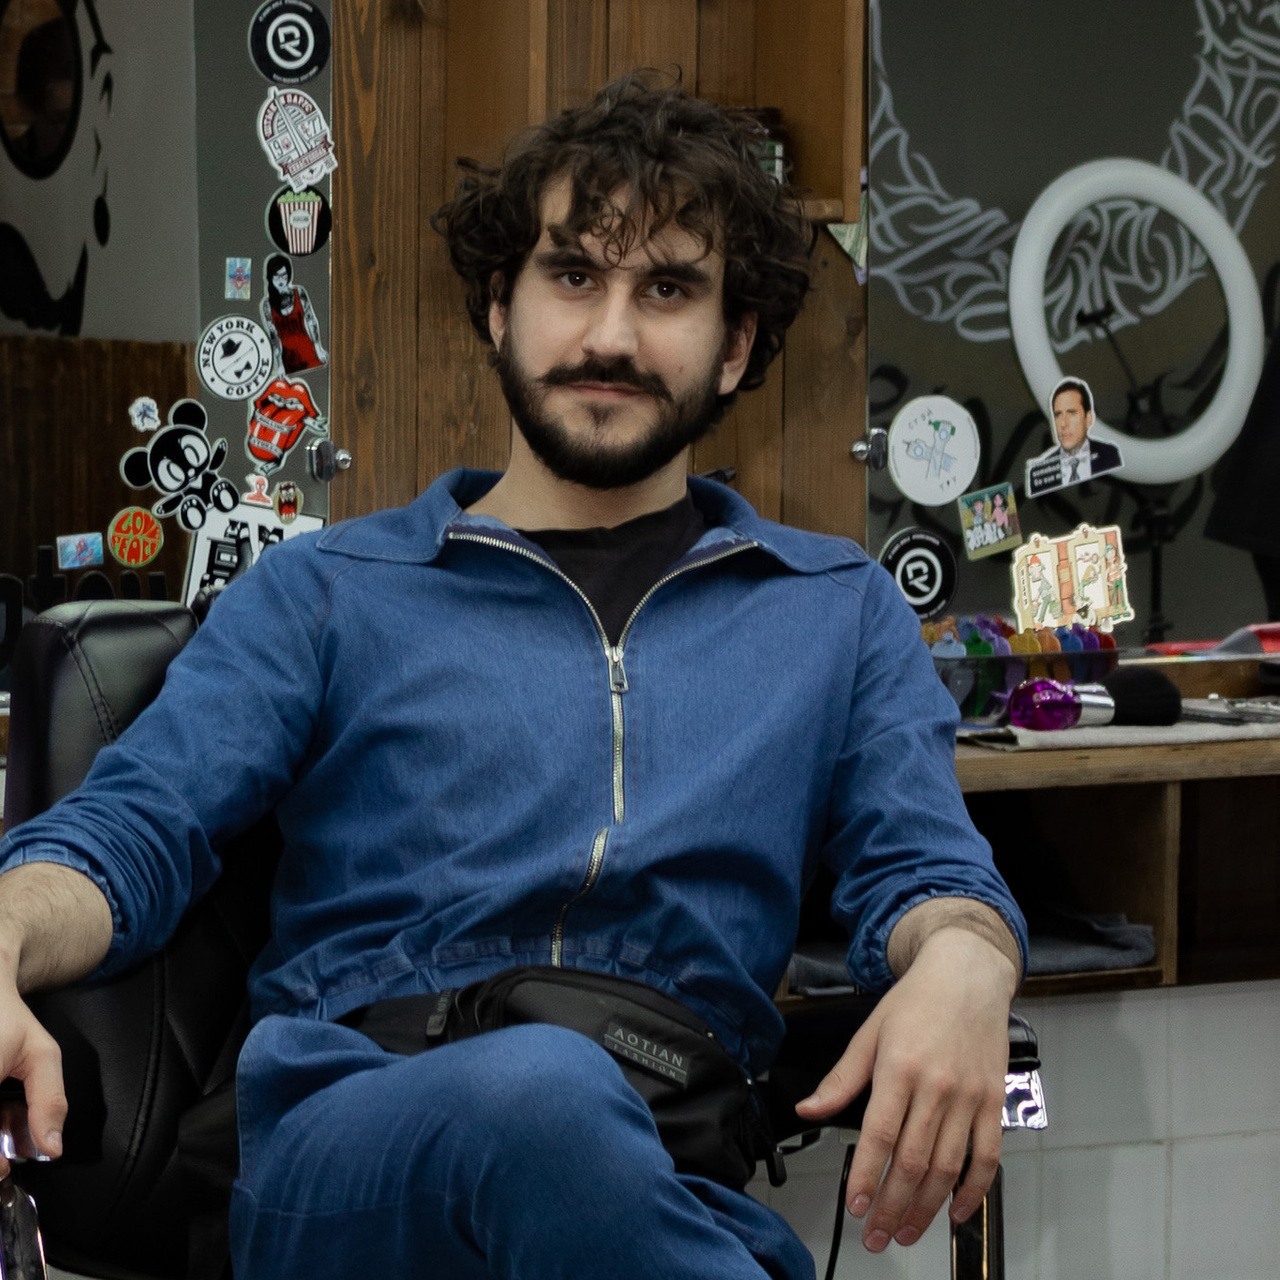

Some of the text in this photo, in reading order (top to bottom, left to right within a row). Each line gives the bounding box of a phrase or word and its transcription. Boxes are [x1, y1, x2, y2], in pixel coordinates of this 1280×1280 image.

[202, 319, 255, 368] NEW YORK
[226, 358, 270, 396] COFFEE
[114, 510, 160, 539] LOVE
[614, 1028, 683, 1067] AOTIAN
